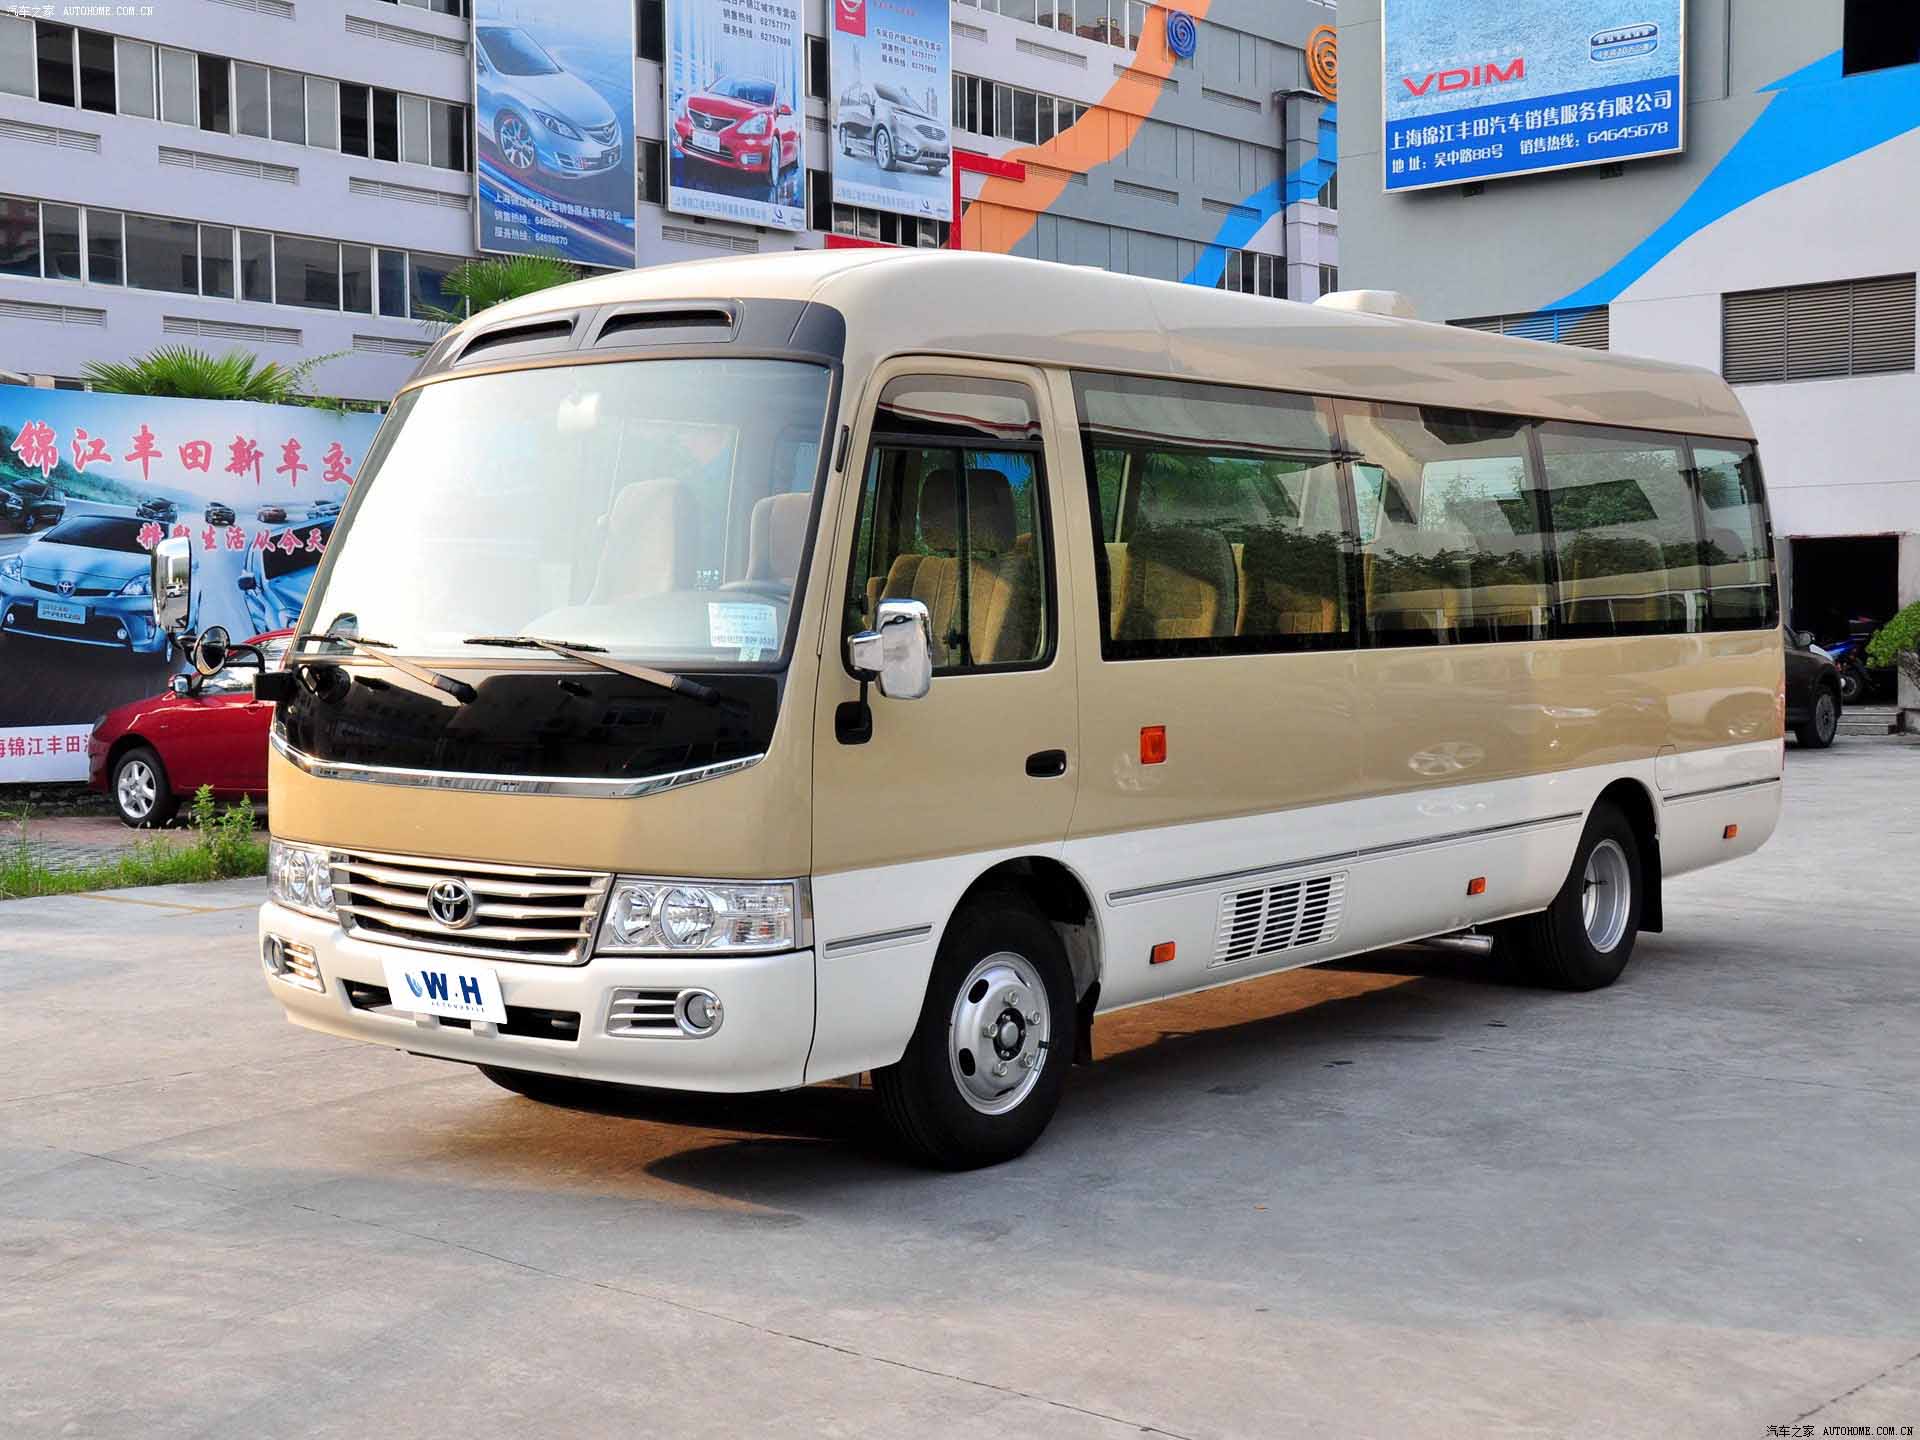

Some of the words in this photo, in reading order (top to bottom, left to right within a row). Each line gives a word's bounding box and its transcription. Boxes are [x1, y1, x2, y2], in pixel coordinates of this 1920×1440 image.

[1403, 57, 1524, 96] VDIM
[1391, 90, 1672, 150] 上海锦江丰田汽车销售服务有限公司
